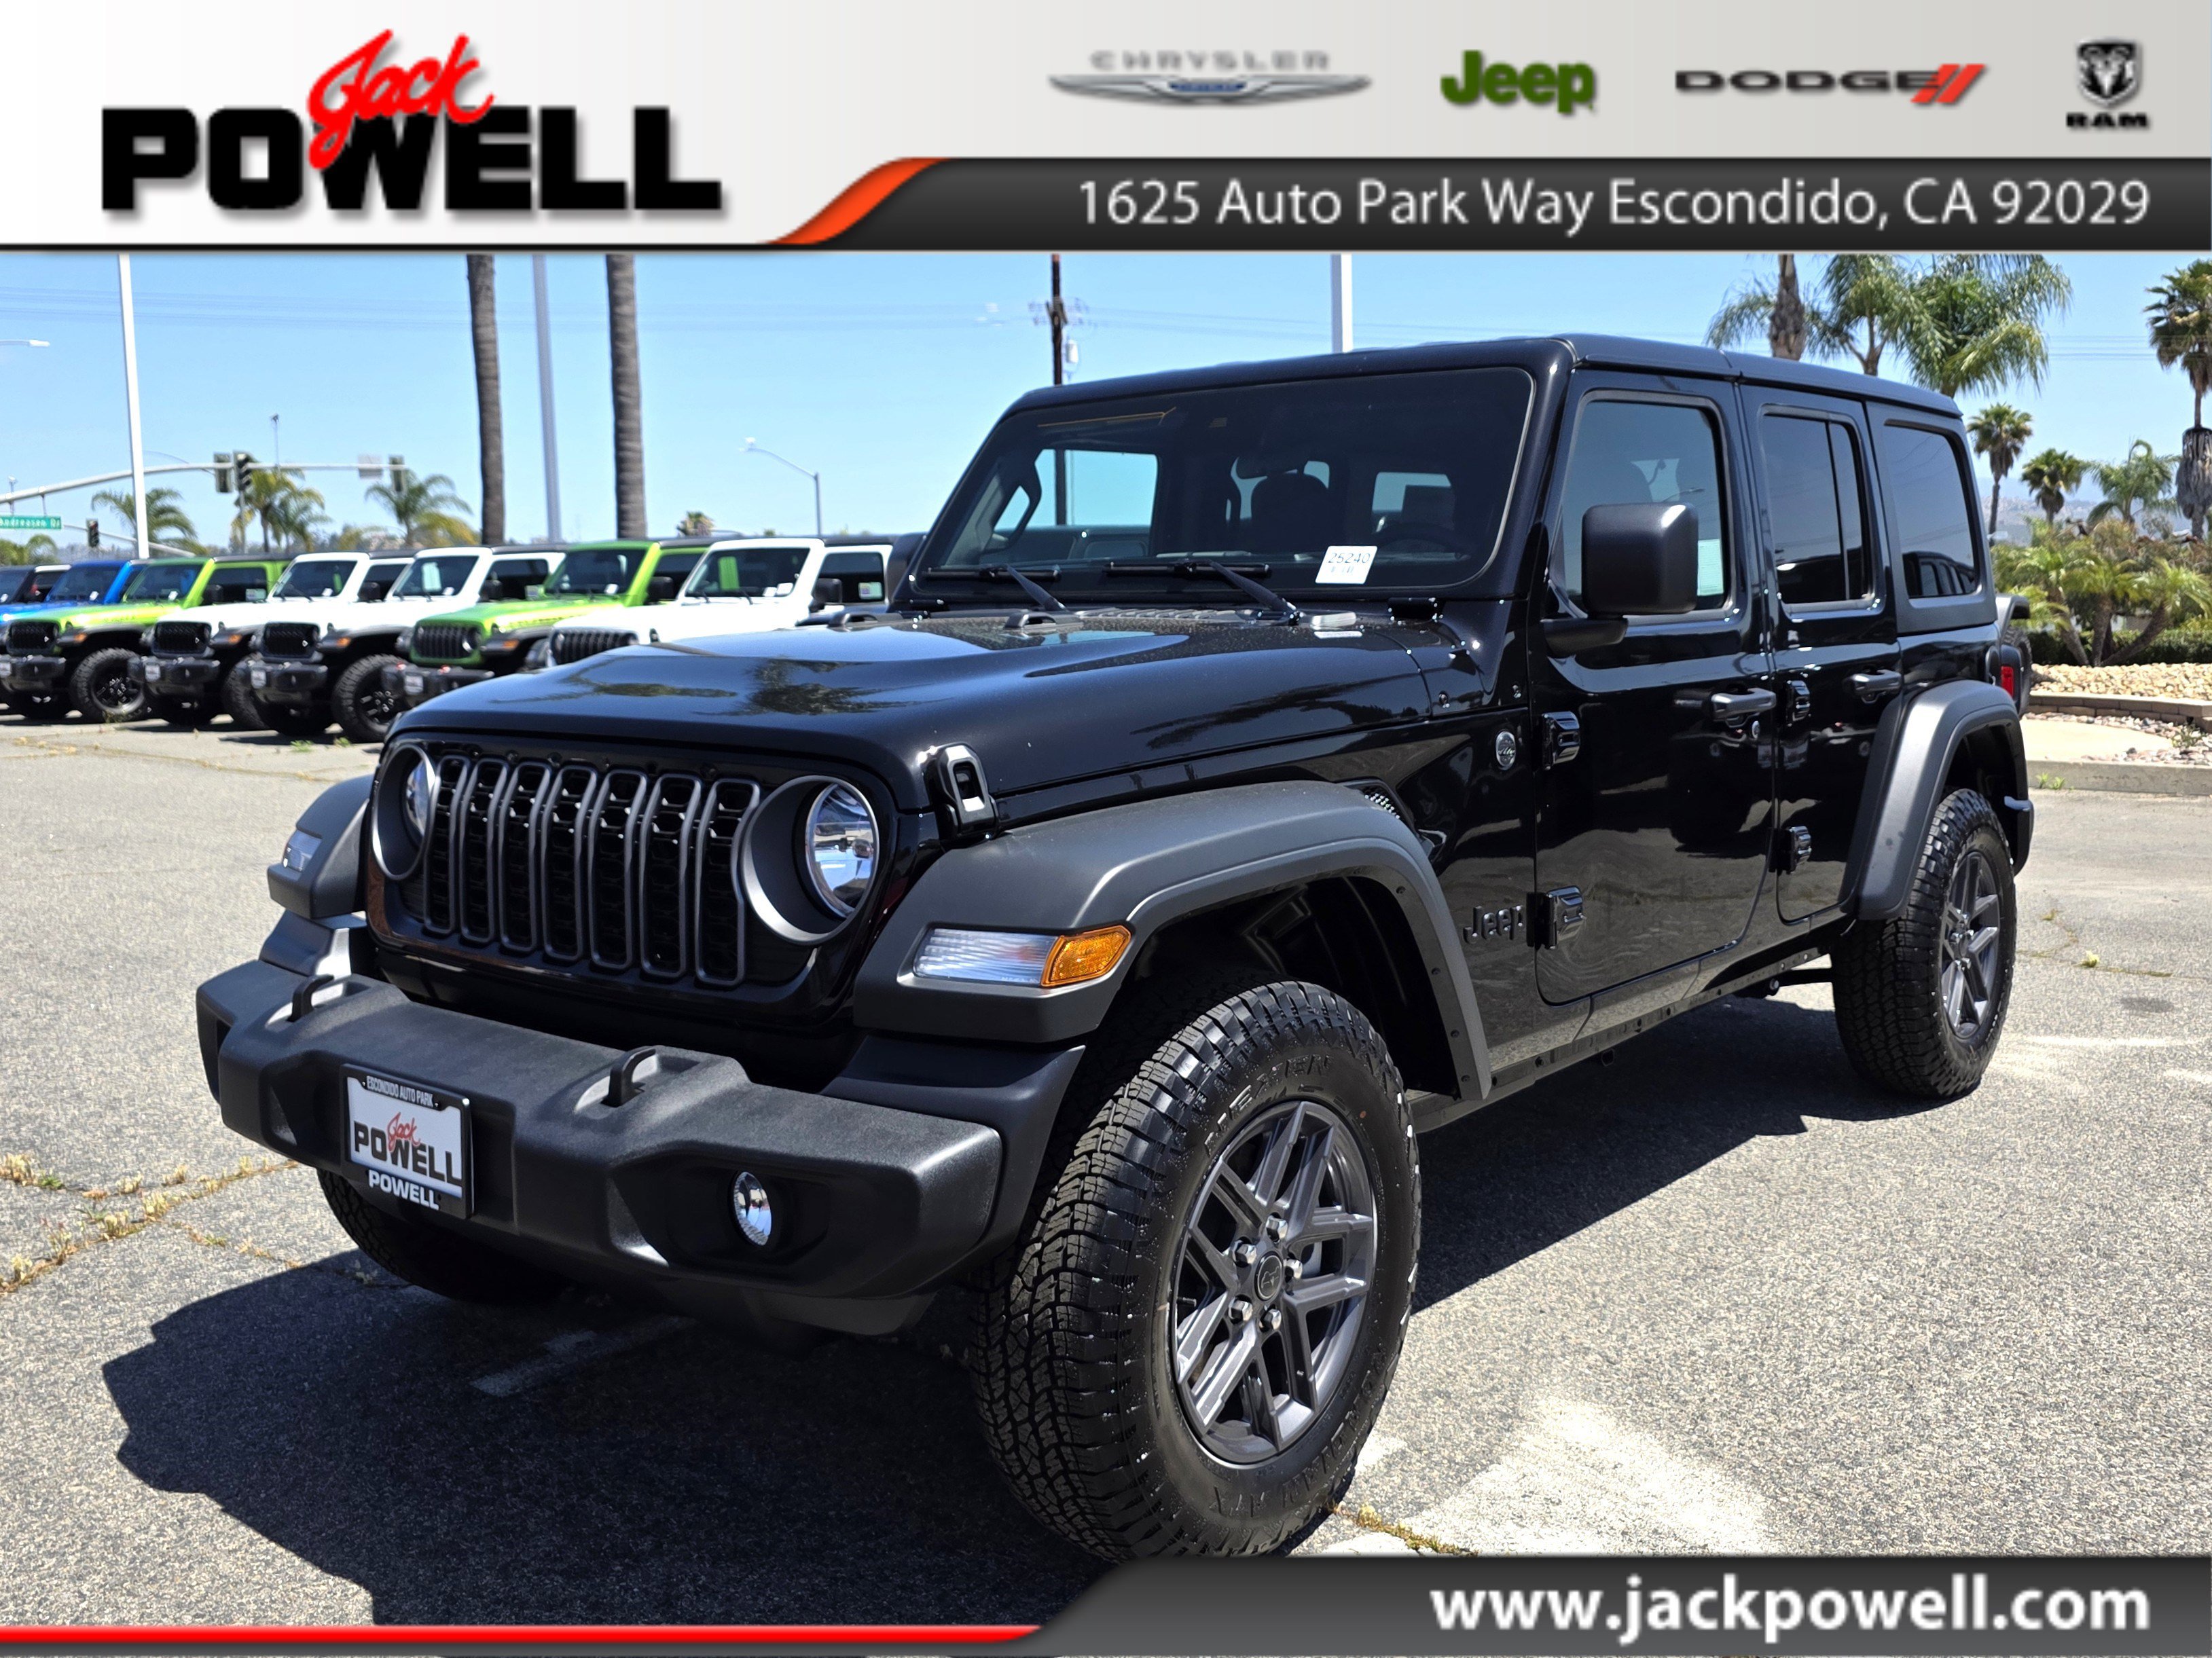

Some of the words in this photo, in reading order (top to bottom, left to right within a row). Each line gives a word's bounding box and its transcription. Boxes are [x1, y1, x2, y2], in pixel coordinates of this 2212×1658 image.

[1328, 552, 1371, 564] 25240
[1463, 905, 1524, 944] Jeep
[367, 1075, 399, 1098] ESCONDIDO
[399, 1086, 416, 1103] AUTO
[416, 1090, 434, 1108] PARK
[387, 1111, 421, 1153] Jack
[354, 1120, 463, 1187] POWELL
[368, 1169, 439, 1211] POWELL
